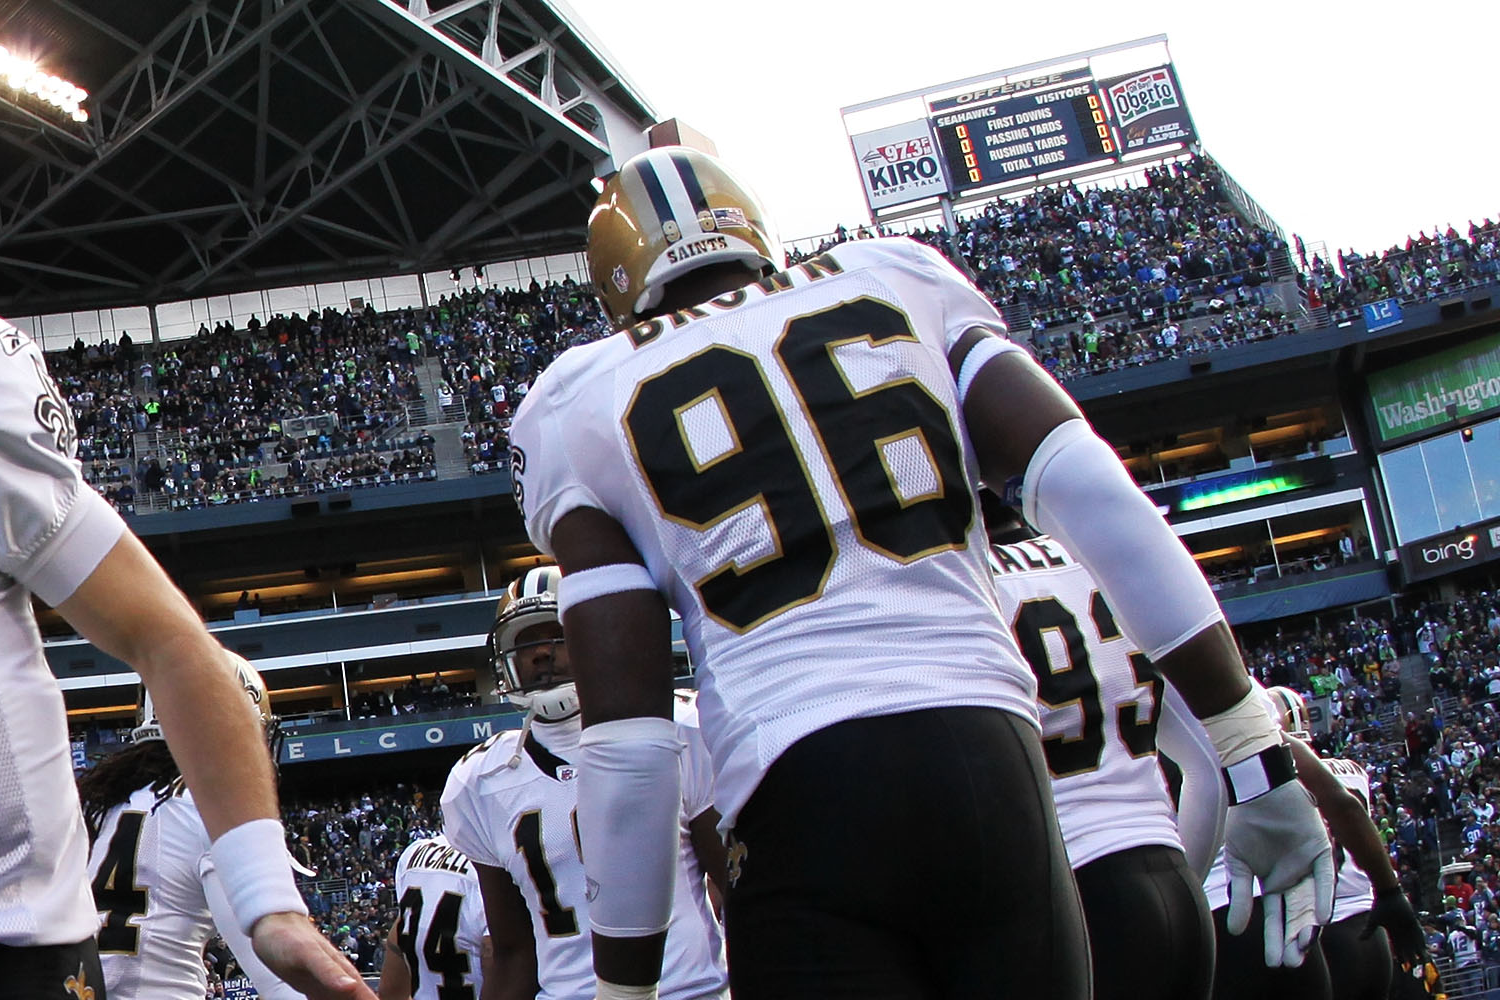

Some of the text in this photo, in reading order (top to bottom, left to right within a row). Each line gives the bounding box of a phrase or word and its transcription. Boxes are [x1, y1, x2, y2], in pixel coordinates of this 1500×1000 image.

[956, 74, 1063, 103] OFFENSE
[1035, 85, 1090, 105] VISITORS
[1116, 83, 1171, 114] Oberto
[1087, 95, 1100, 110] 0
[937, 106, 997, 127] SEAHAWKS
[987, 107, 1053, 131] FIRST DOWNS
[1092, 110, 1105, 124] 0
[956, 124, 968, 139] 0
[985, 120, 1063, 147] PASSING YARDS
[1097, 125, 1110, 139] 0
[885, 140, 923, 162] 97.3
[960, 139, 973, 154] 0
[989, 134, 1069, 161] RUSHING YARDS
[1102, 139, 1114, 153] 0
[964, 154, 977, 168] 0
[1001, 151, 1066, 174] TOTAL YARDS
[868, 157, 937, 190] KIRO
[969, 168, 981, 182] 0
[873, 177, 942, 197] NEWS TALK
[661, 220, 680, 242] 9
[667, 235, 728, 264] SAINTS
[1372, 301, 1393, 321] 12
[621, 294, 975, 635] 96
[1422, 537, 1474, 564] bing
[1011, 588, 1166, 778] 93
